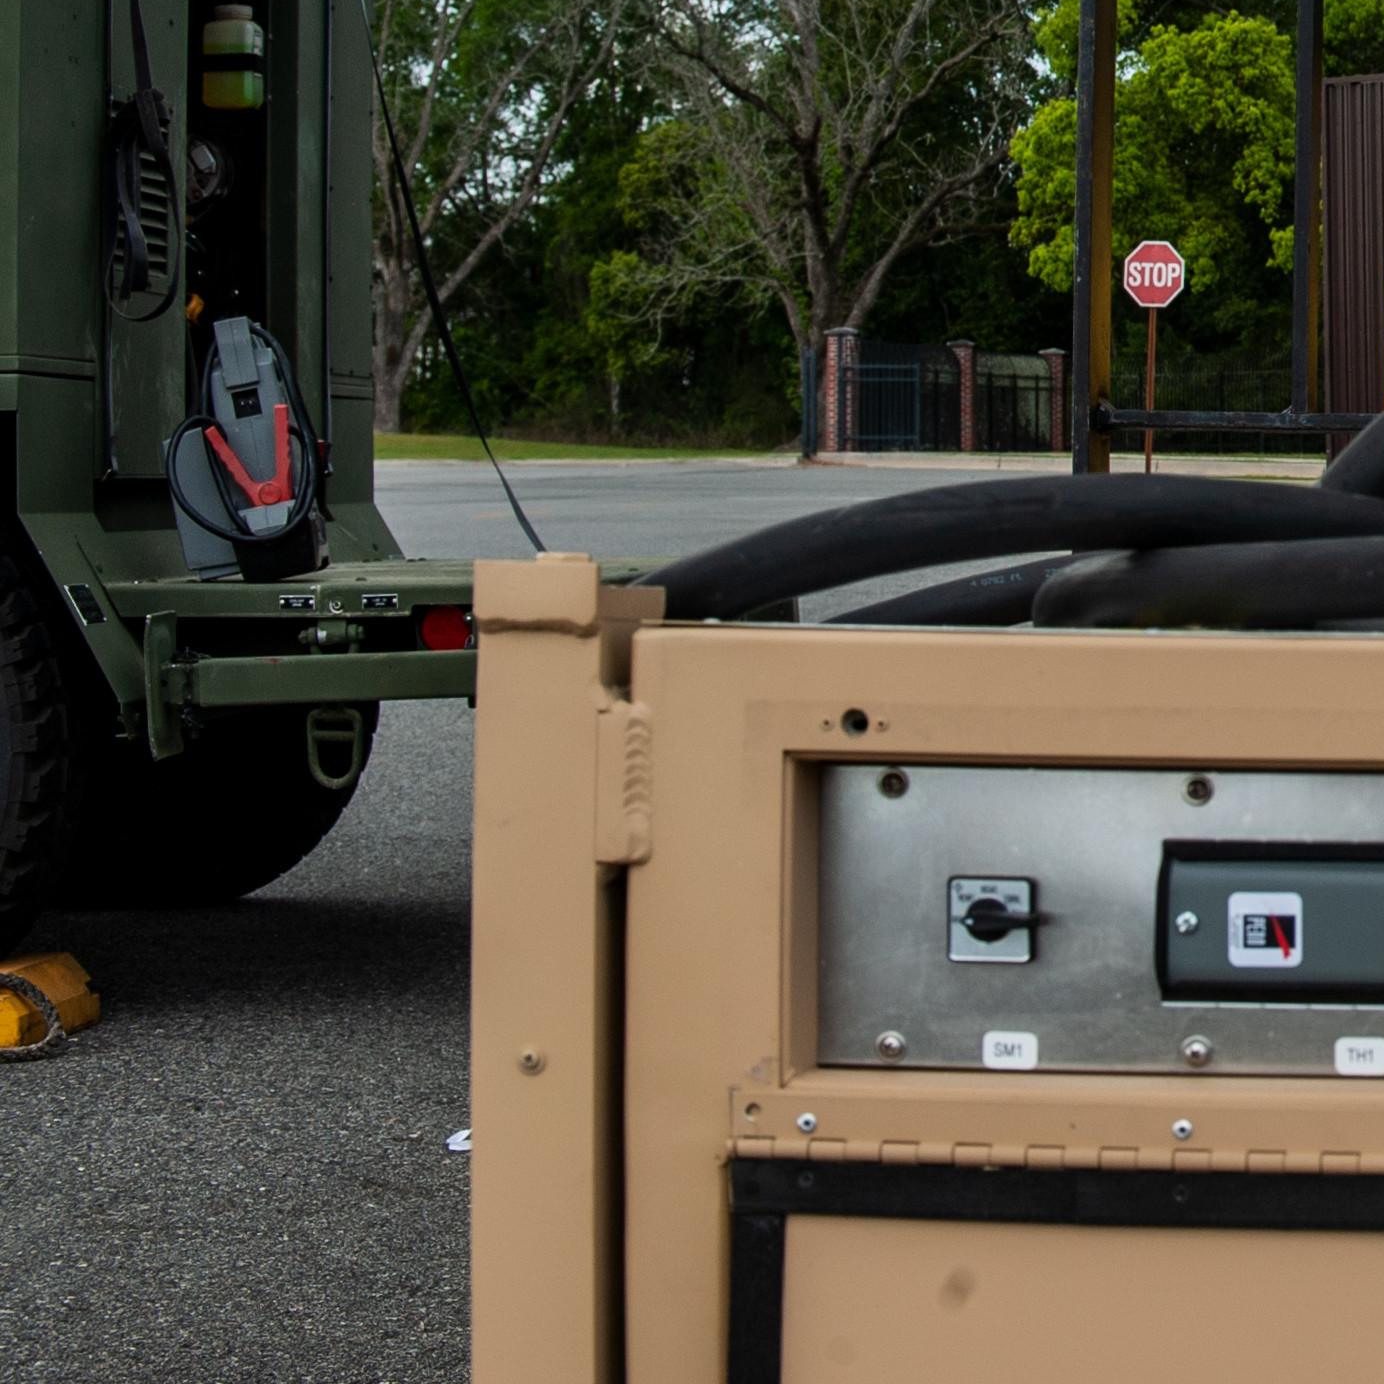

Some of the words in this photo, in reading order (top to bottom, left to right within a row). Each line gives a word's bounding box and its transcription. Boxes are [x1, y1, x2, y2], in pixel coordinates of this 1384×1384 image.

[1128, 262, 1180, 287] STOP
[993, 1041, 1022, 1058] SM1
[1347, 1047, 1374, 1063] TH1
